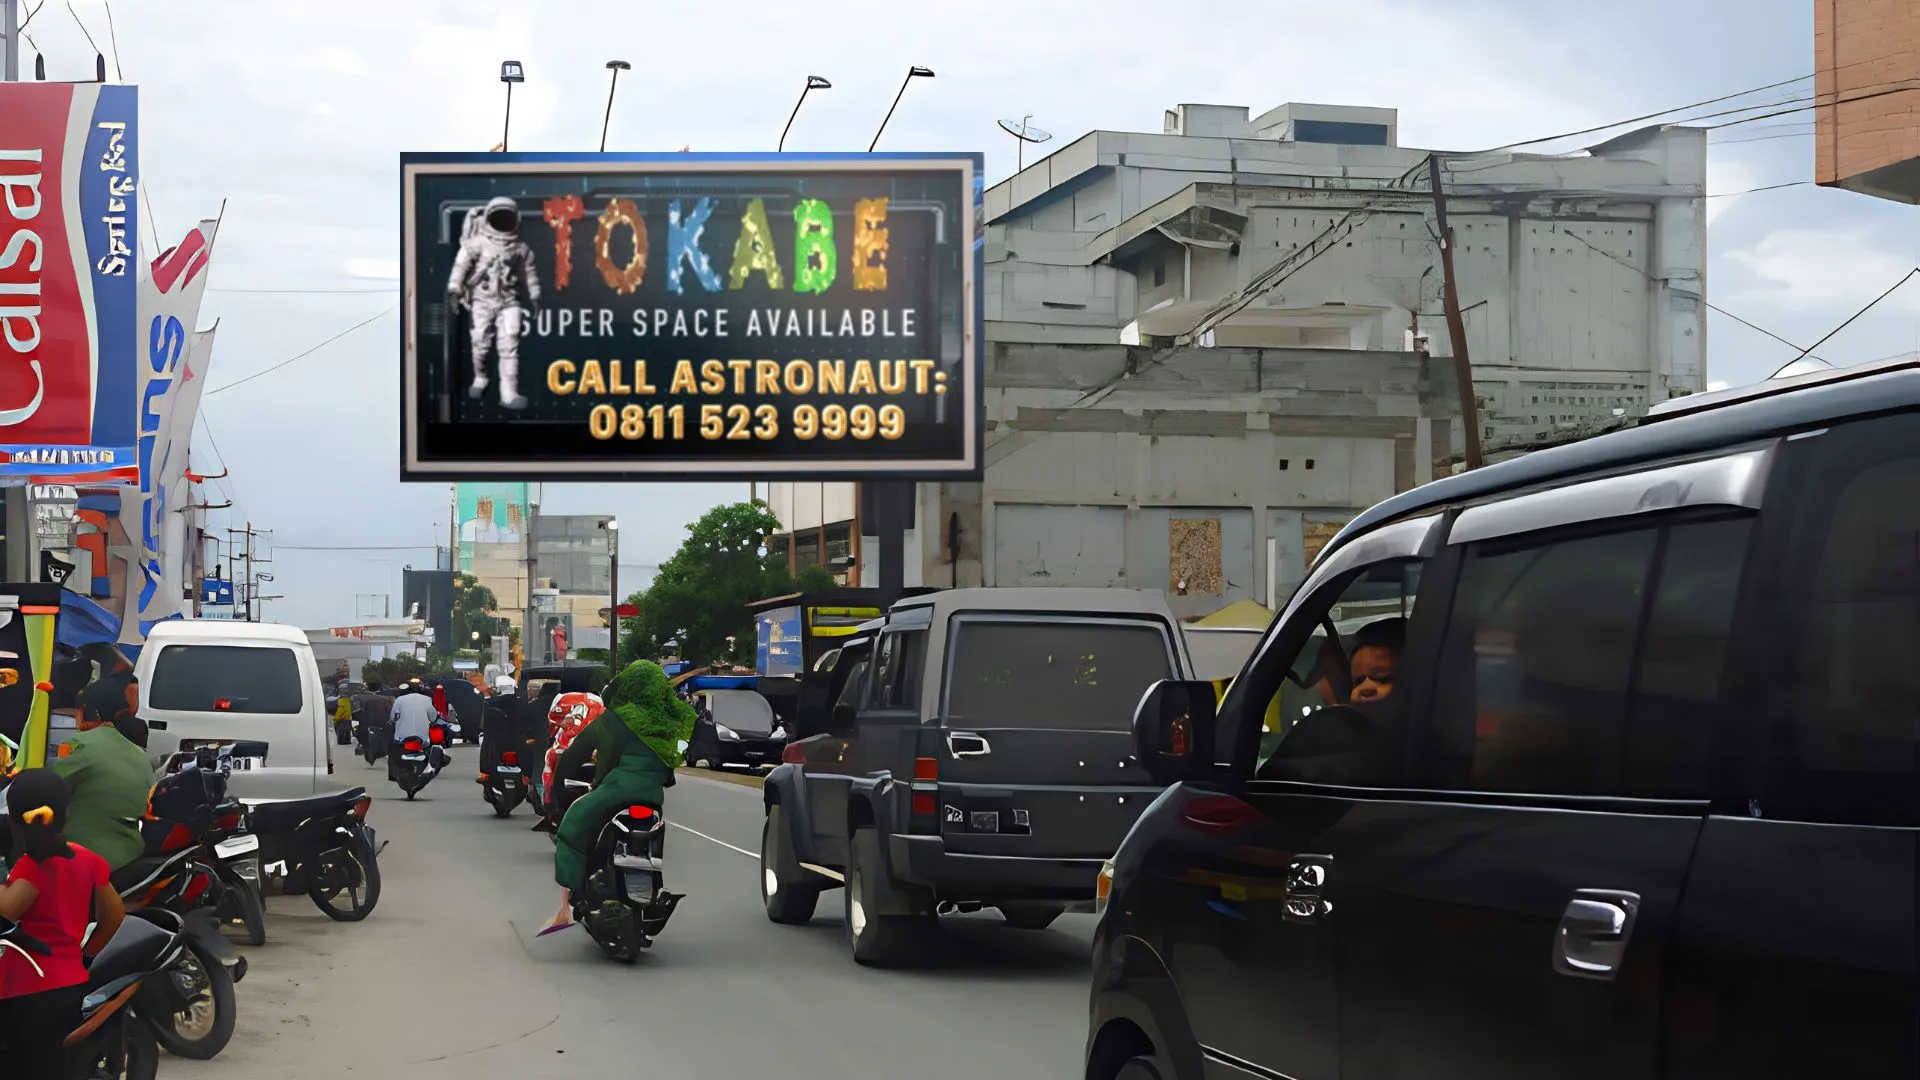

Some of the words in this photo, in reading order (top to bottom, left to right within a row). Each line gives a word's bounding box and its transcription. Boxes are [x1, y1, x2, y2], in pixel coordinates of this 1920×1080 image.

[543, 194, 889, 295] TOKABE
[521, 308, 614, 337] SUPER
[633, 308, 729, 337] SPACE
[746, 308, 915, 337] AVAILABLE
[547, 359, 656, 394] CALL
[670, 359, 947, 395] ASTRONAUT:
[589, 404, 685, 440] 0811
[700, 404, 779, 440] 523
[793, 404, 905, 440] 9999
